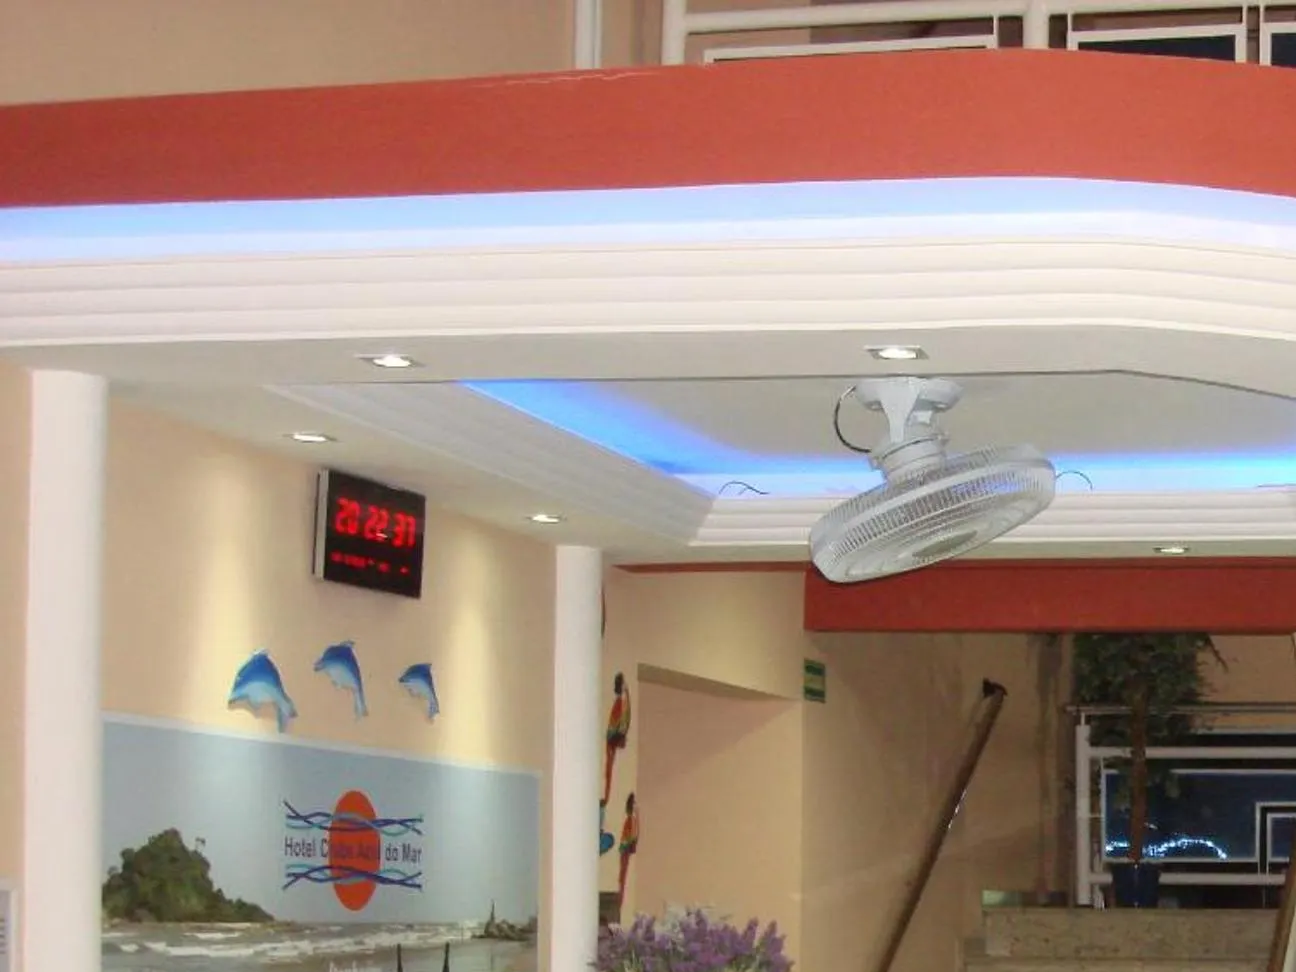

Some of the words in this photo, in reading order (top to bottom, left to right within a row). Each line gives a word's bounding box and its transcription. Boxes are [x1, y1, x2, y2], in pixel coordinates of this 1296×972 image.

[284, 836, 317, 858] Hotel
[385, 843, 398, 861] do
[402, 843, 422, 863] Mar
